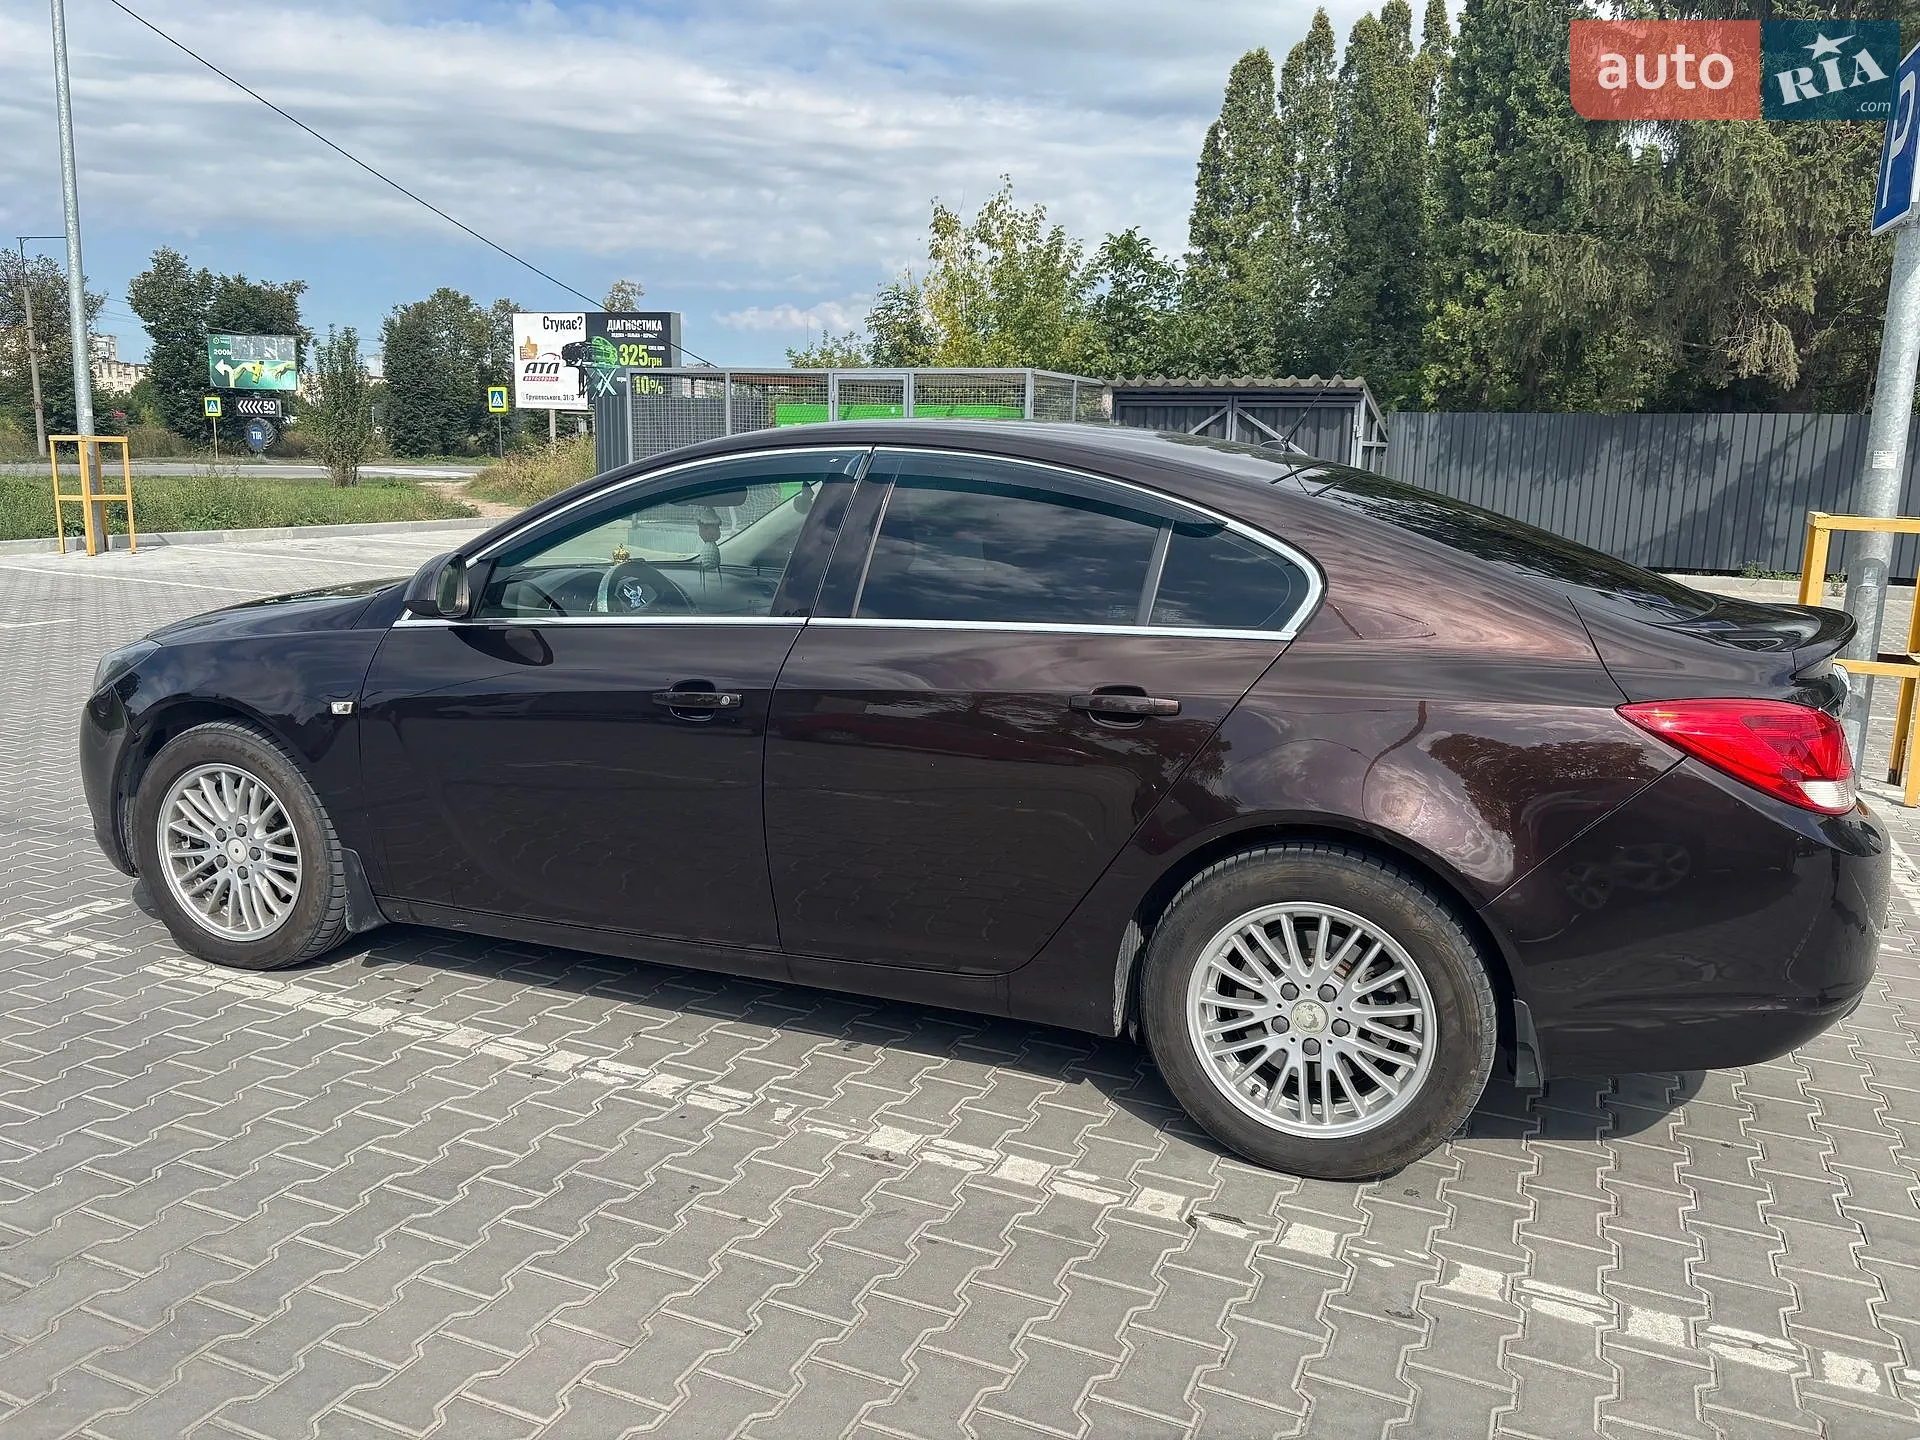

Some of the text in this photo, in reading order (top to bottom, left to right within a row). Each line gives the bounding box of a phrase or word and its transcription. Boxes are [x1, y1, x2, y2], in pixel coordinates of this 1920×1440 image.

[1881, 69, 1915, 209] P
[543, 315, 583, 332] Стукає?
[606, 319, 663, 332] ДІАГНОСТИКА
[524, 361, 560, 374] АТЛ
[263, 401, 275, 411] 50
[251, 431, 262, 440] TIR
